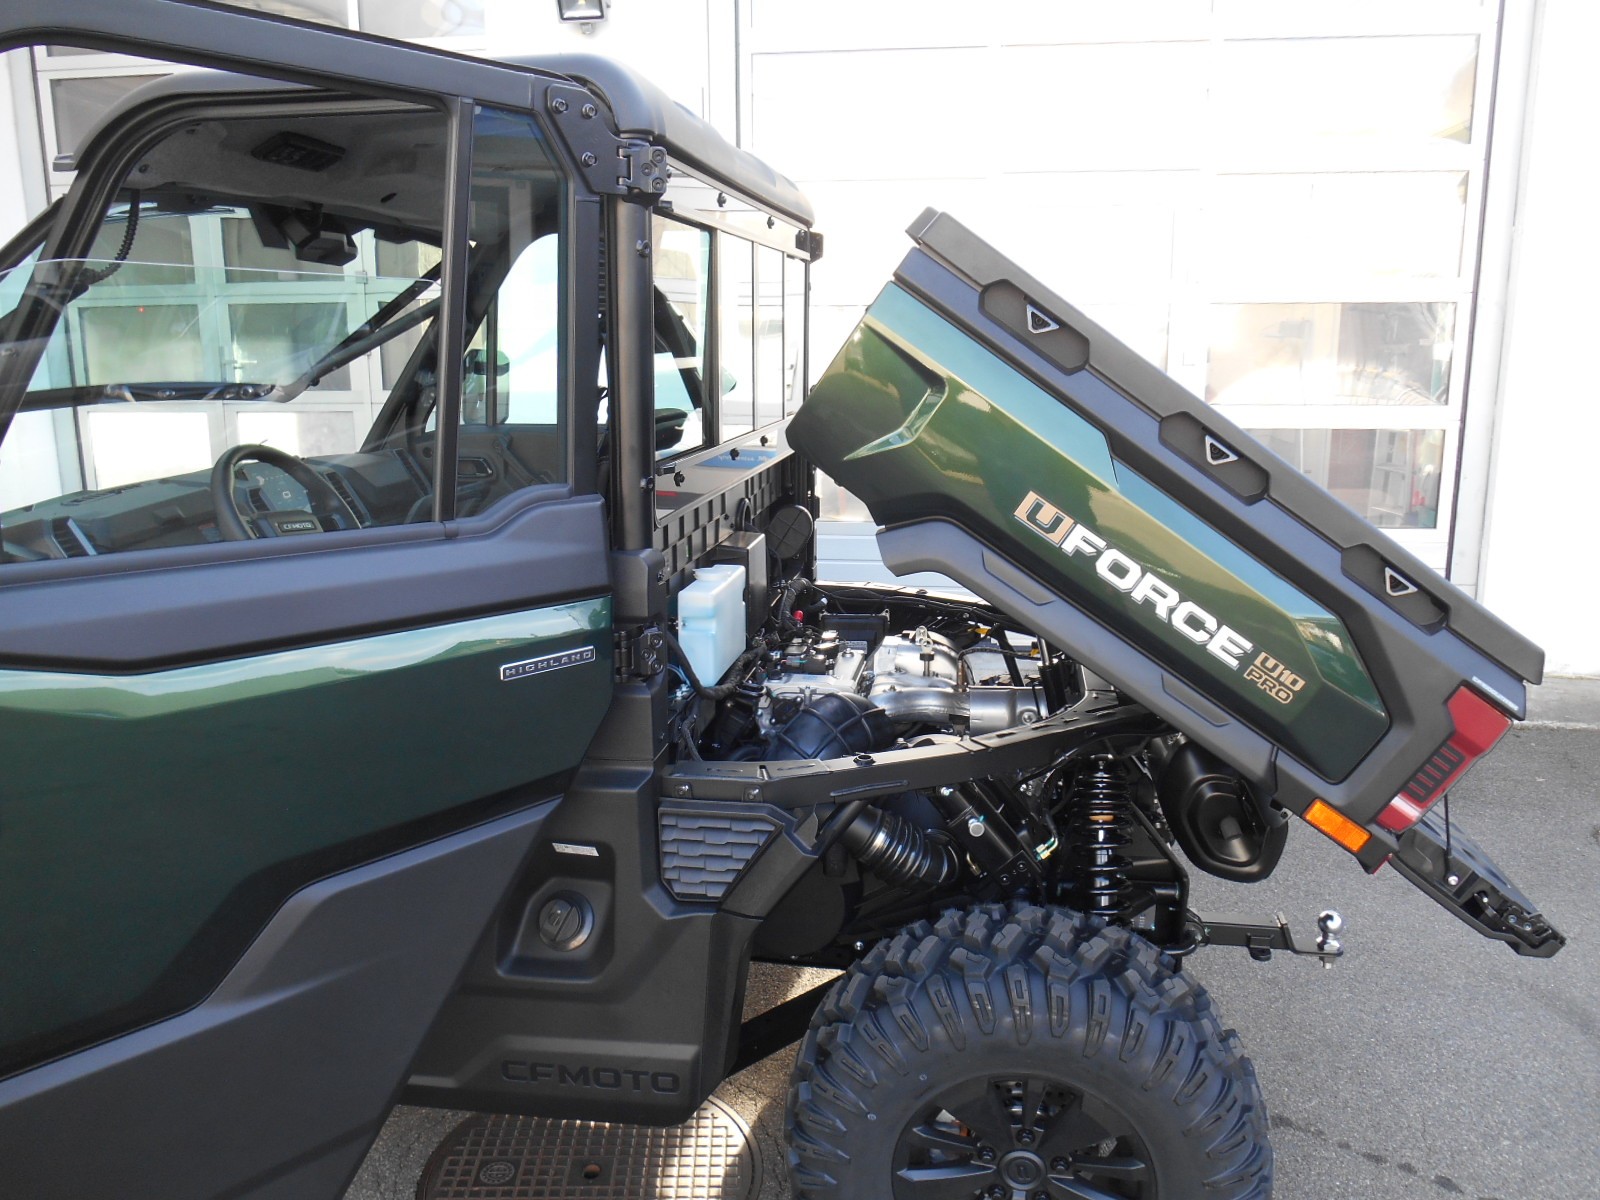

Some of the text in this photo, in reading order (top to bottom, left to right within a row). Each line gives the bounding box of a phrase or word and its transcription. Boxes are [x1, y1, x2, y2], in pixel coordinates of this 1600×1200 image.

[505, 650, 592, 676] HIGHLAND
[1254, 651, 1306, 691] U10
[1243, 665, 1293, 704] PRO
[501, 1059, 681, 1095] CFMOTO
